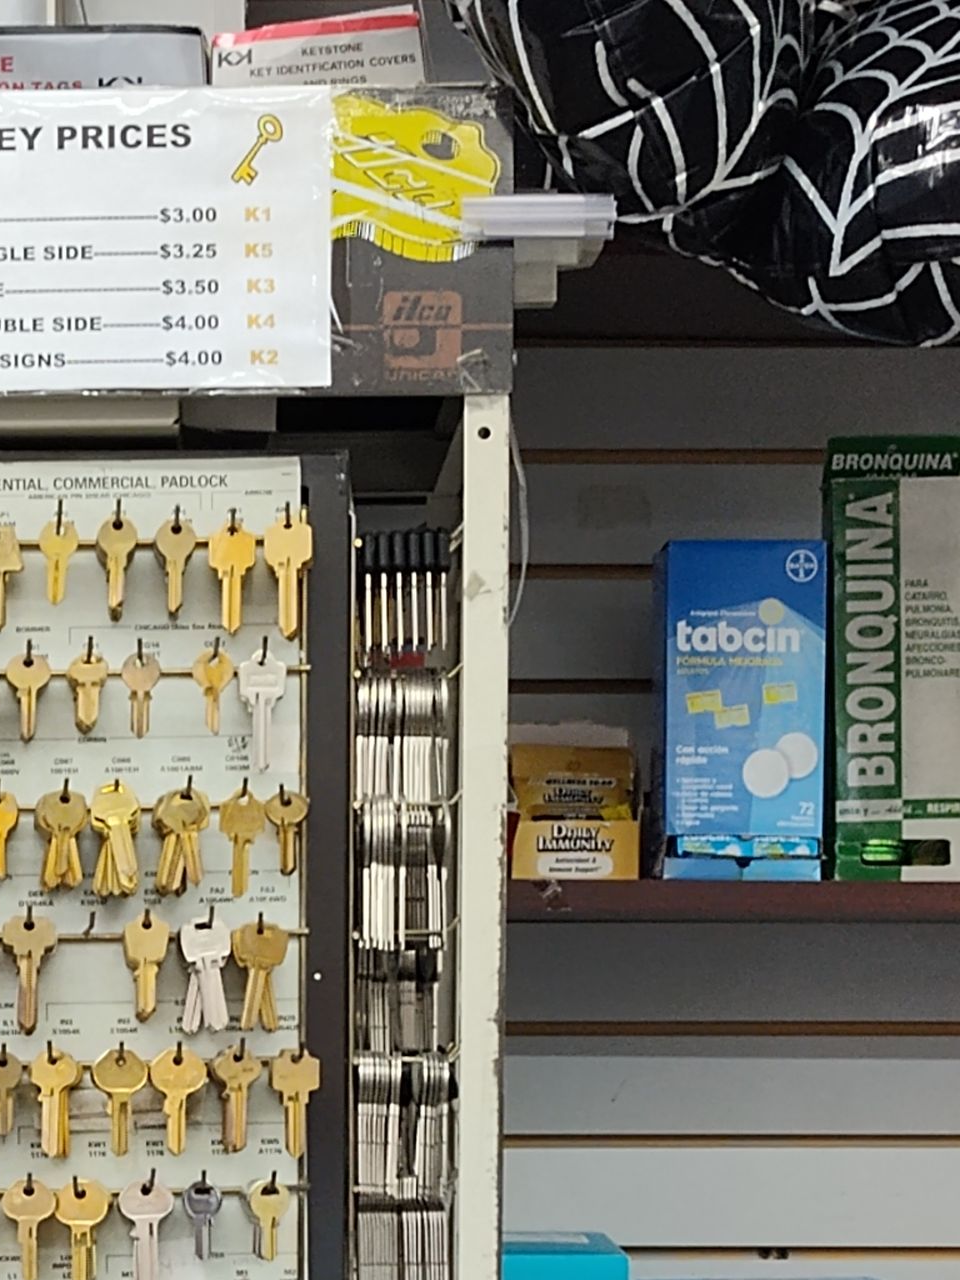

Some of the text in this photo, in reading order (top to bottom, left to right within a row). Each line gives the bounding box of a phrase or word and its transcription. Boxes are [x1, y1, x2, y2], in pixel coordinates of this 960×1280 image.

[301, 43, 363, 57] KEYSTONE
[249, 67, 272, 78] KEY
[369, 53, 416, 67] COVERS
[56, 124, 192, 150] PRICES
[159, 207, 217, 223] $3.00
[243, 206, 272, 223] K1
[43, 244, 94, 261] SIDE
[159, 242, 217, 260] $3.25
[243, 242, 273, 259] K5
[161, 279, 219, 295] $3.50
[246, 278, 276, 294] K3
[52, 316, 102, 332] SIDE
[161, 314, 219, 331] $4.00
[246, 313, 276, 329] K4
[165, 350, 222, 367] $4.00
[249, 349, 279, 366] K2
[831, 453, 954, 471] BRONQUINA
[161, 474, 229, 488] PADLOCK
[904, 579, 929, 588] PARA
[677, 619, 801, 653] tabcin
[845, 491, 898, 787] BRONQUINA
[552, 823, 601, 840] DAILY
[537, 836, 614, 852] IMMUNITY
